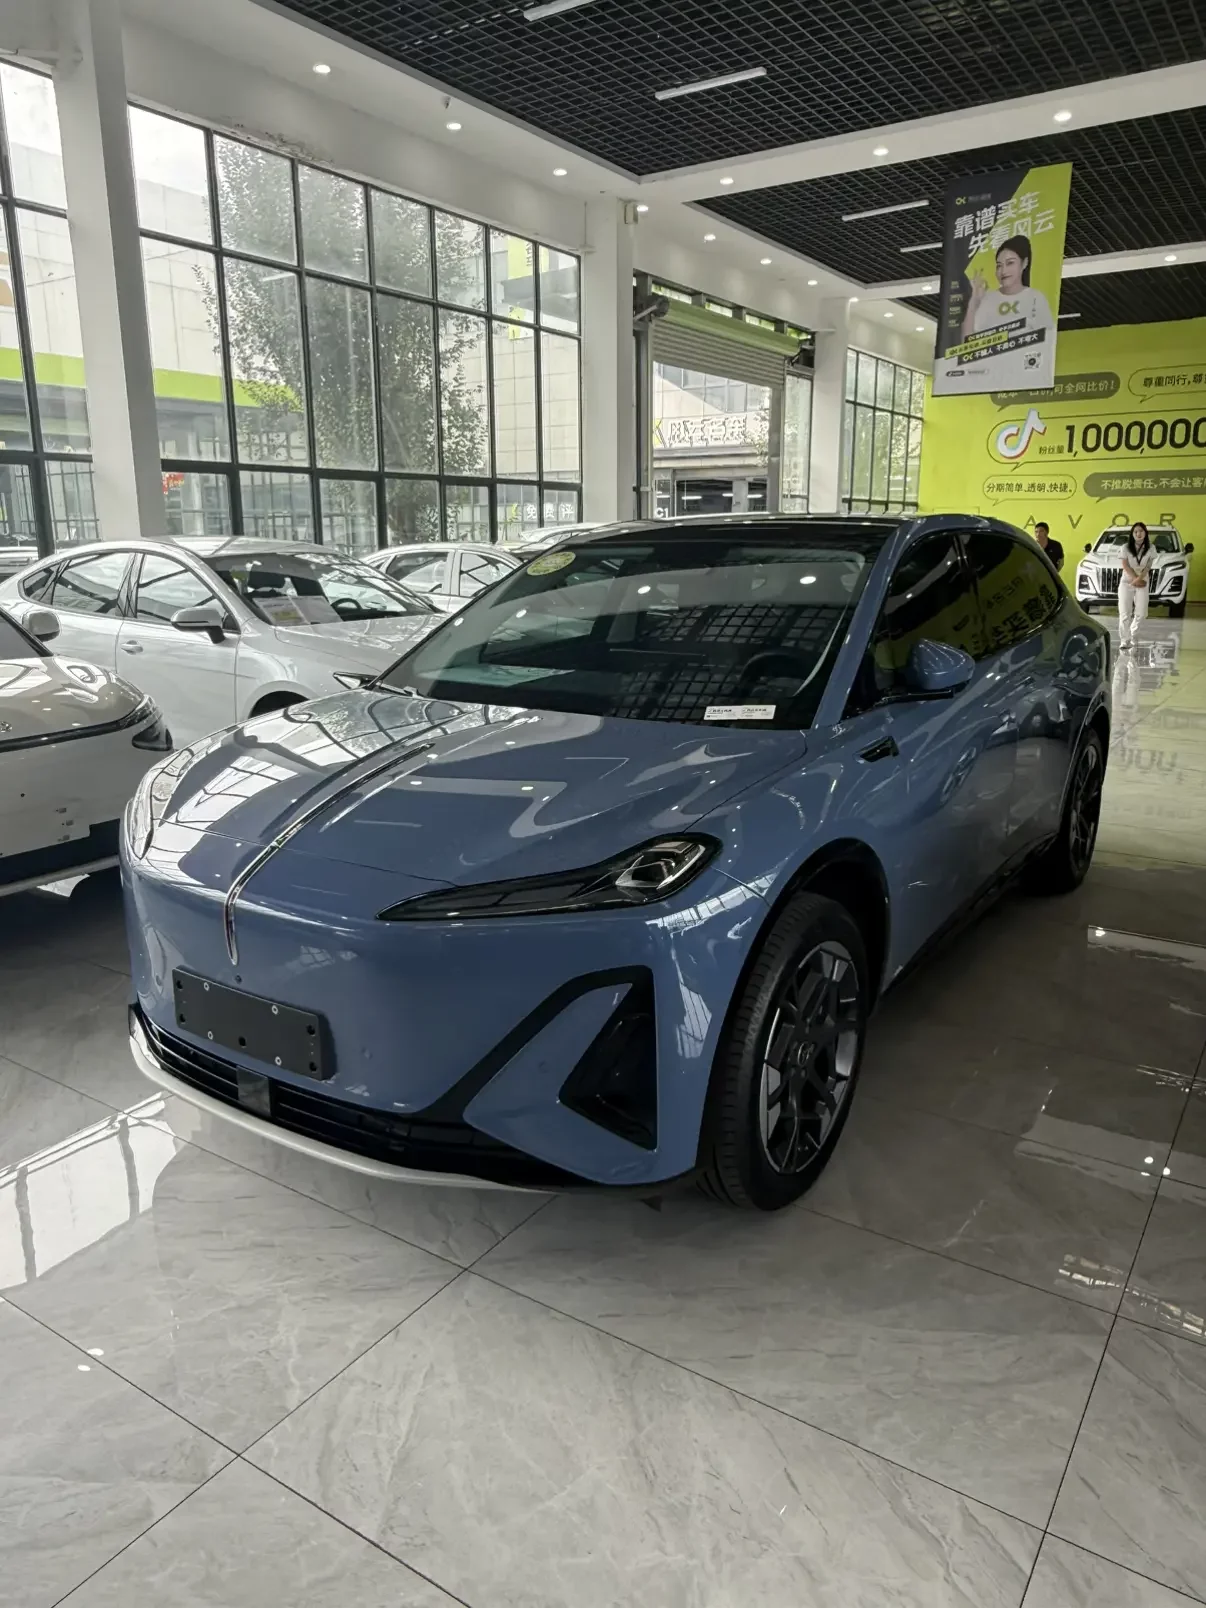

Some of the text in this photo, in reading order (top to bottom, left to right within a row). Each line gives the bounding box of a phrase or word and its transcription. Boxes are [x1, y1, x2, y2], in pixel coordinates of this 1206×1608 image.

[953, 191, 1041, 239] 靠谱买车
[967, 208, 1056, 258] 先看风云
[1038, 445, 1065, 456] 粉丝量
